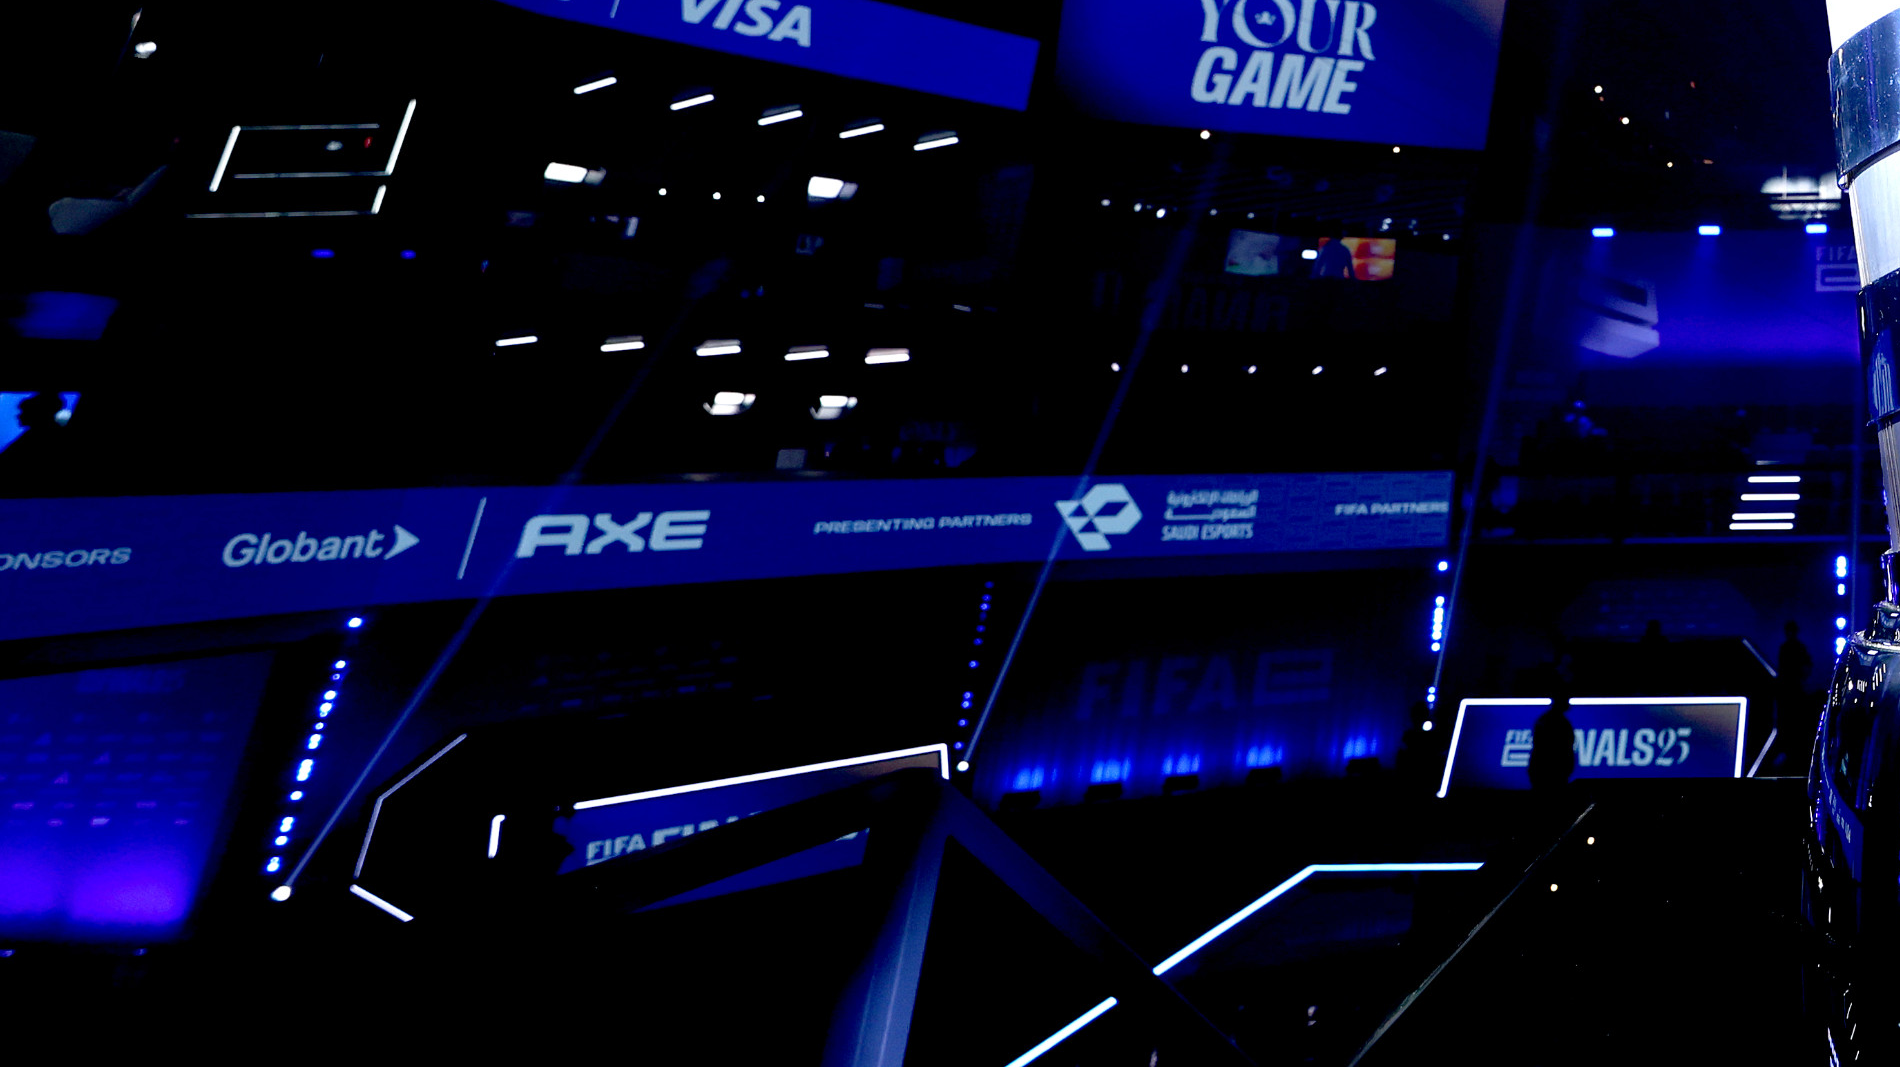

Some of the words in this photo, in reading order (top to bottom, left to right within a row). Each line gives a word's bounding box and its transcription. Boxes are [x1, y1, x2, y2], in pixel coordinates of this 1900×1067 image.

[1190, 45, 1366, 115] GAME
[813, 516, 936, 535] PRESENTING
[937, 512, 1033, 529] PARTNERS
[1335, 502, 1369, 516] FIFA
[1370, 500, 1449, 515] PARTNERS
[222, 529, 385, 567] Globant
[516, 509, 711, 558] AXE
[586, 833, 647, 862] FIFA
